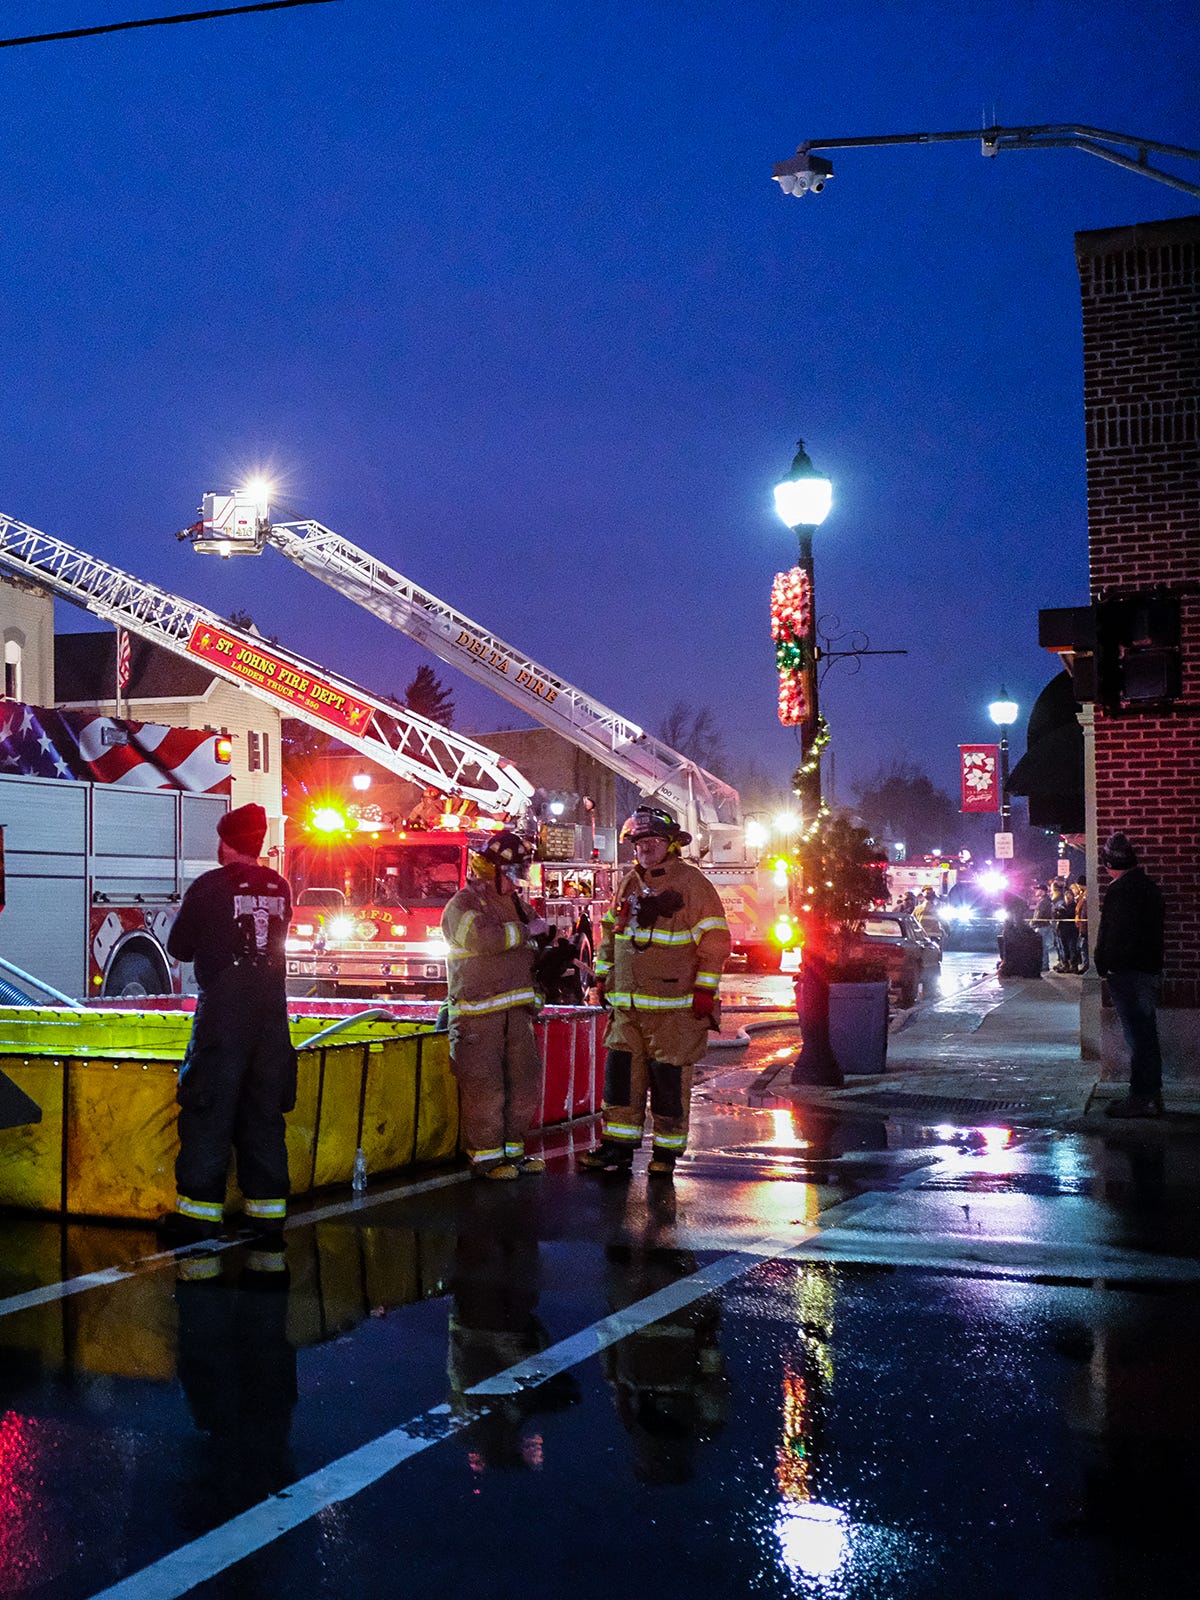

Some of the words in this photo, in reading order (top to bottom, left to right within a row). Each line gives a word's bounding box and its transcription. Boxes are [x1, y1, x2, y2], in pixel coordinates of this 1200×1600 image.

[216, 638, 234, 656] ST.
[236, 648, 276, 676] JOHNS
[277, 668, 309, 693] FIRE
[310, 684, 345, 711] DEPT.
[231, 661, 265, 683] LADDER
[267, 679, 295, 698] TRUCK
[455, 631, 510, 674] DELTA
[515, 669, 558, 704] FIRE
[661, 787, 673, 797] 100
